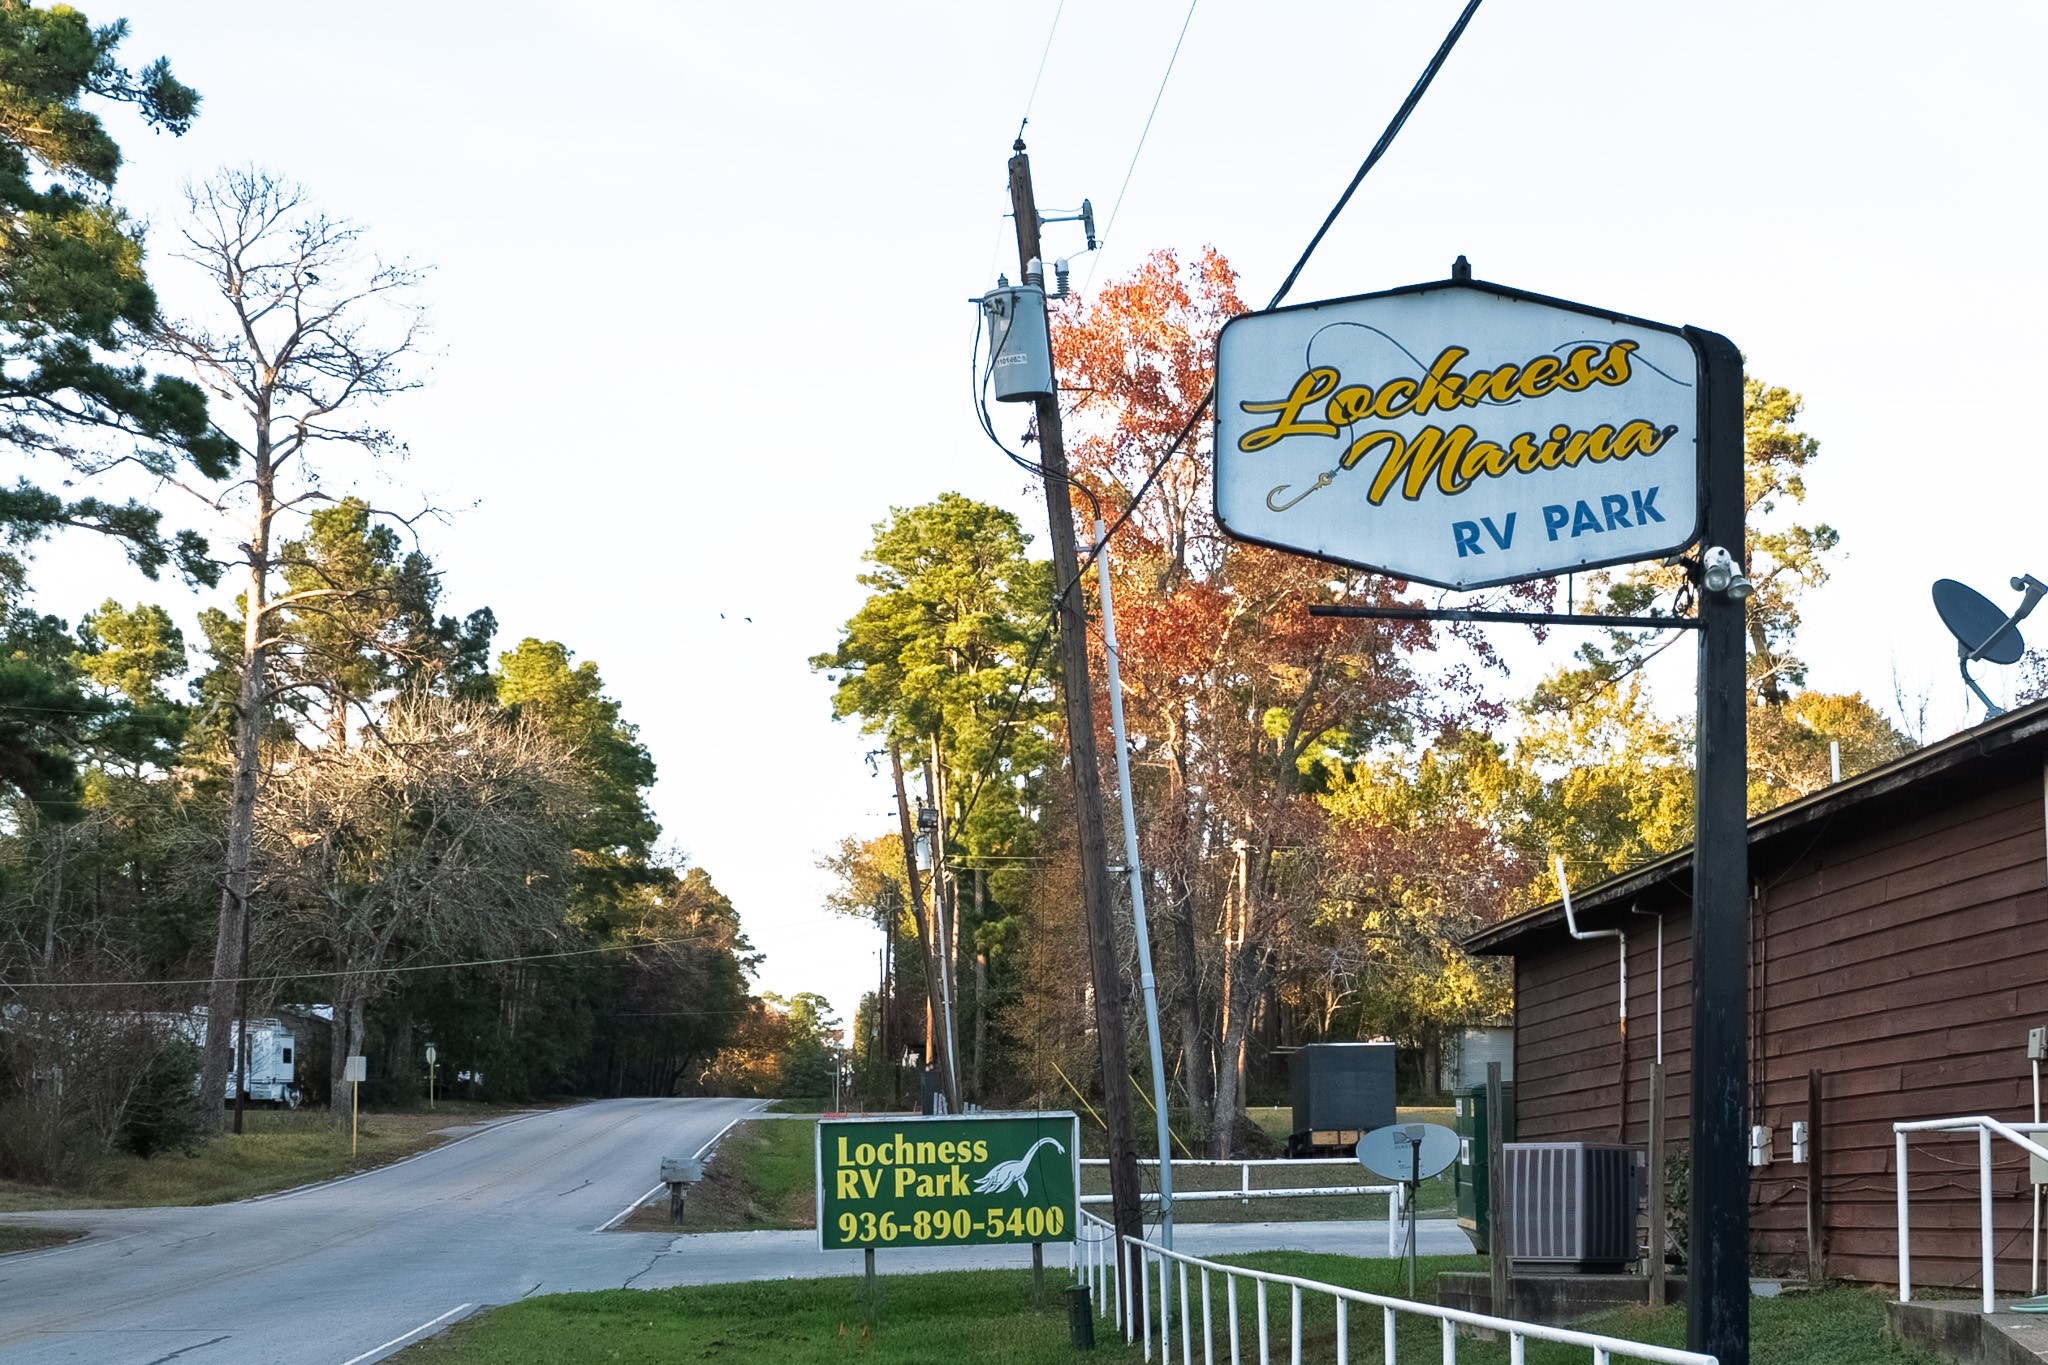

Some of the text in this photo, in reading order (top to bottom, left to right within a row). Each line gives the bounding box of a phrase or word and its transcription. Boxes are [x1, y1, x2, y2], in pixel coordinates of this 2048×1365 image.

[1238, 339, 1641, 453] Lochness
[1342, 418, 1679, 506] Marina
[1451, 485, 1667, 559] RV PARK
[837, 1133, 989, 1167] Lochness
[836, 1164, 971, 1200] RV Park
[838, 1205, 1065, 1243] 936-890-5400
